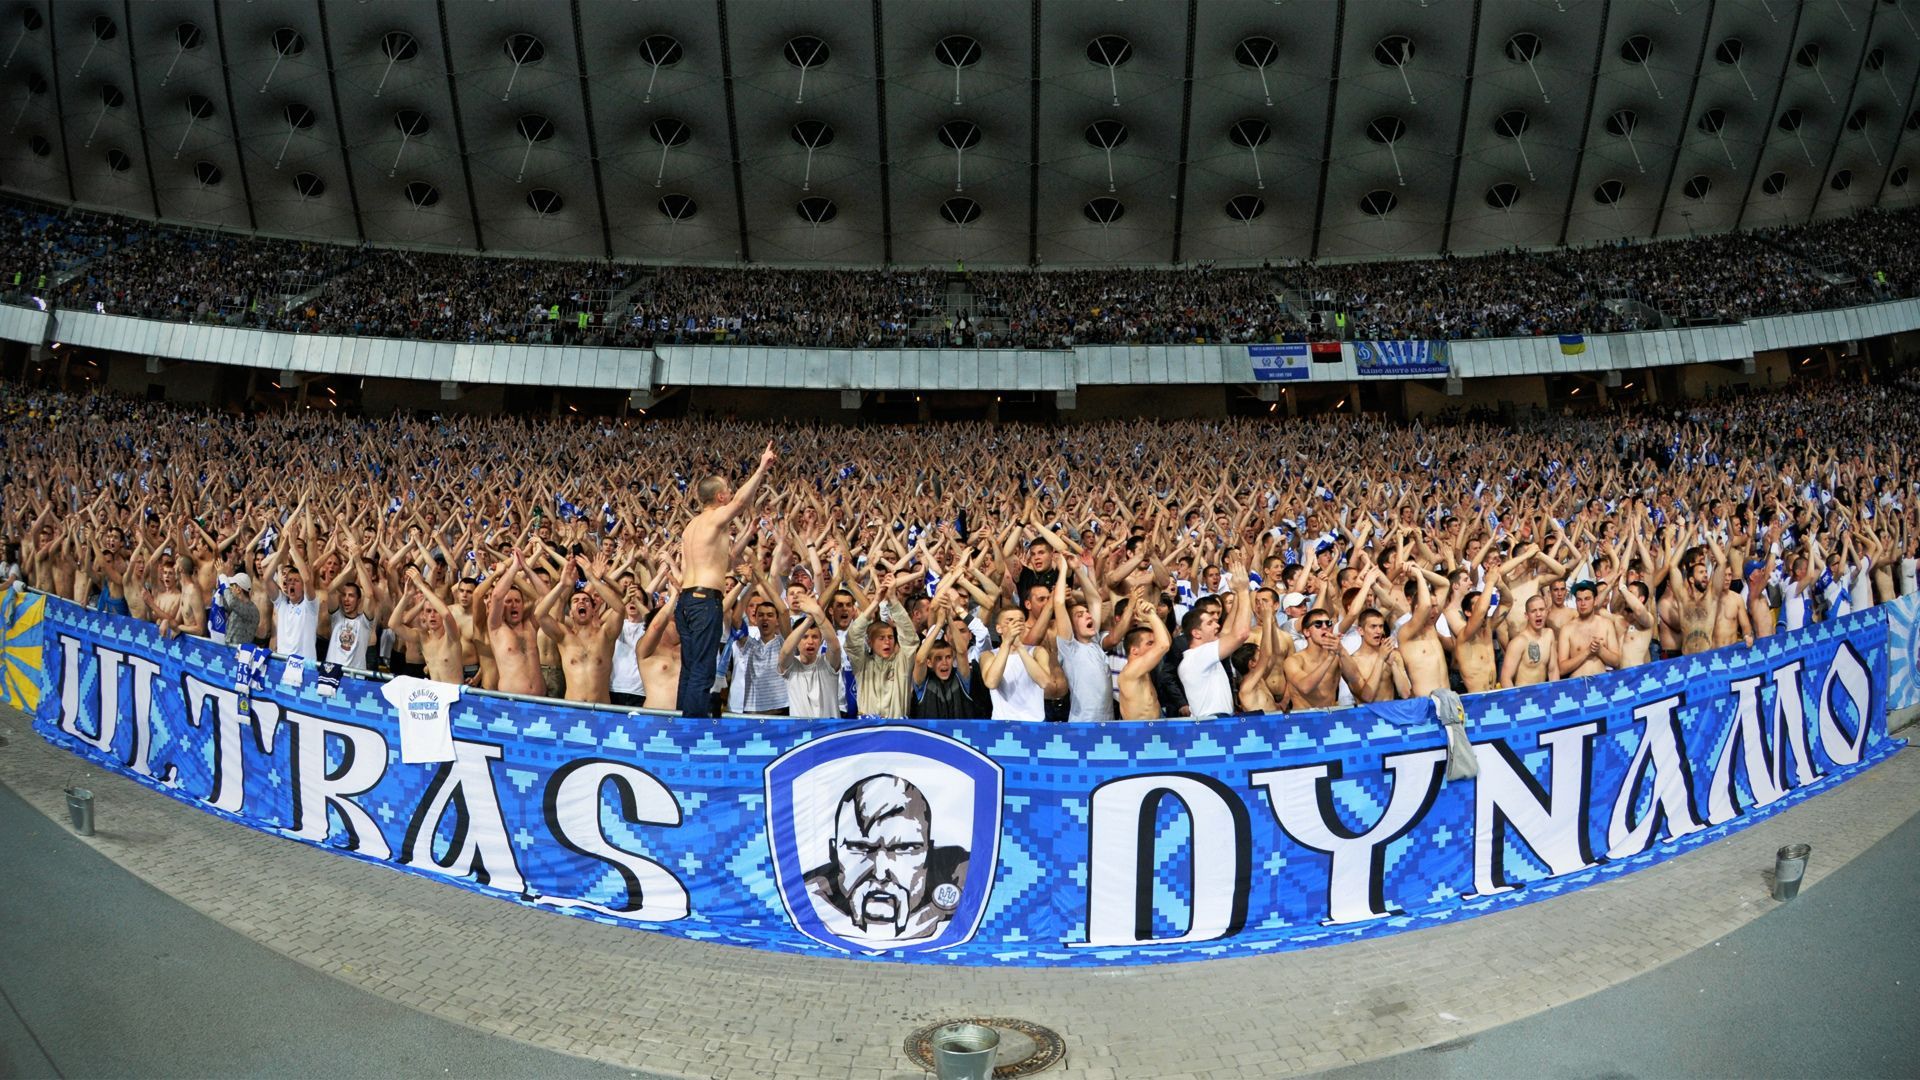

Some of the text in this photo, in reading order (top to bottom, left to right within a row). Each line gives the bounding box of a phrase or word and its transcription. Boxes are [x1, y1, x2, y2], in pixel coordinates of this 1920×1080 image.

[238, 662, 248, 674] FC
[57, 632, 1873, 948] ULTRAS DYNAMO
